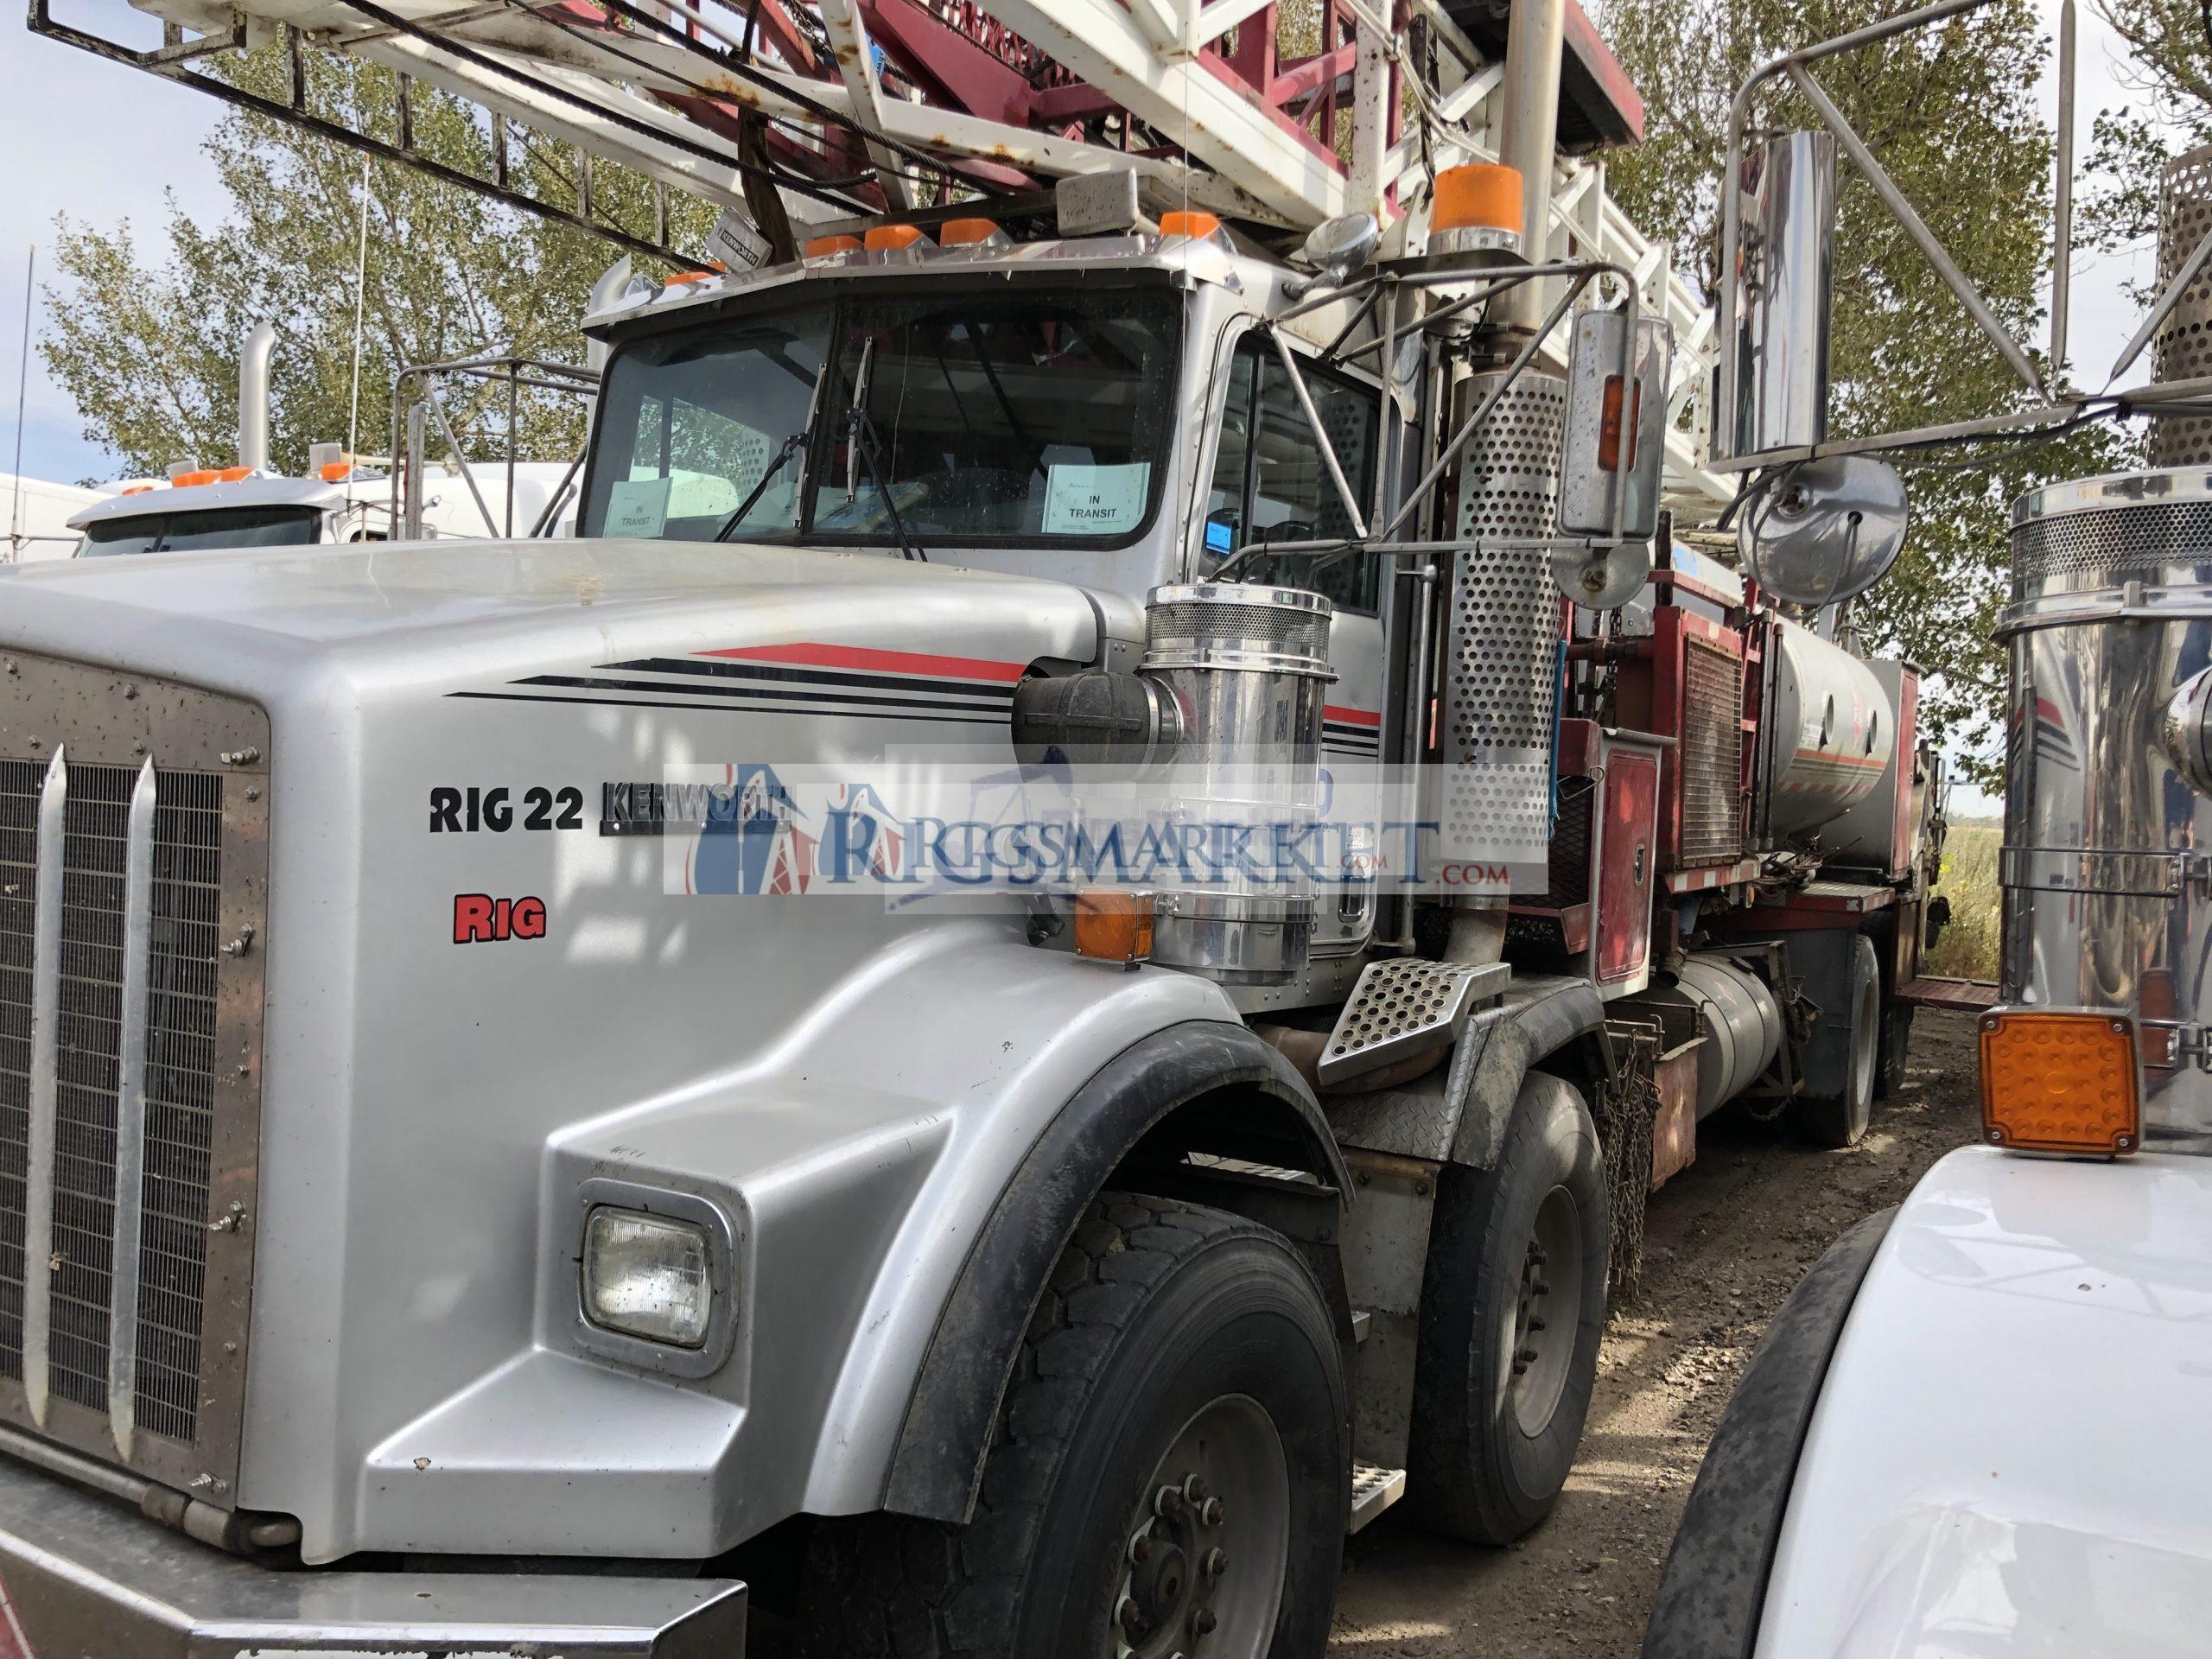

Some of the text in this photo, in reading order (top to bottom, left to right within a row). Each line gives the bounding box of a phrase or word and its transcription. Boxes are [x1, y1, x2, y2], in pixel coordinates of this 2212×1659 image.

[721, 231, 758, 264] KENWORTH
[1089, 495, 1101, 505] IN
[621, 517, 651, 526] TRANSIT
[1069, 508, 1117, 518] TRANSIT
[429, 786, 583, 833] RIG 22
[602, 782, 792, 822] KENWORTH
